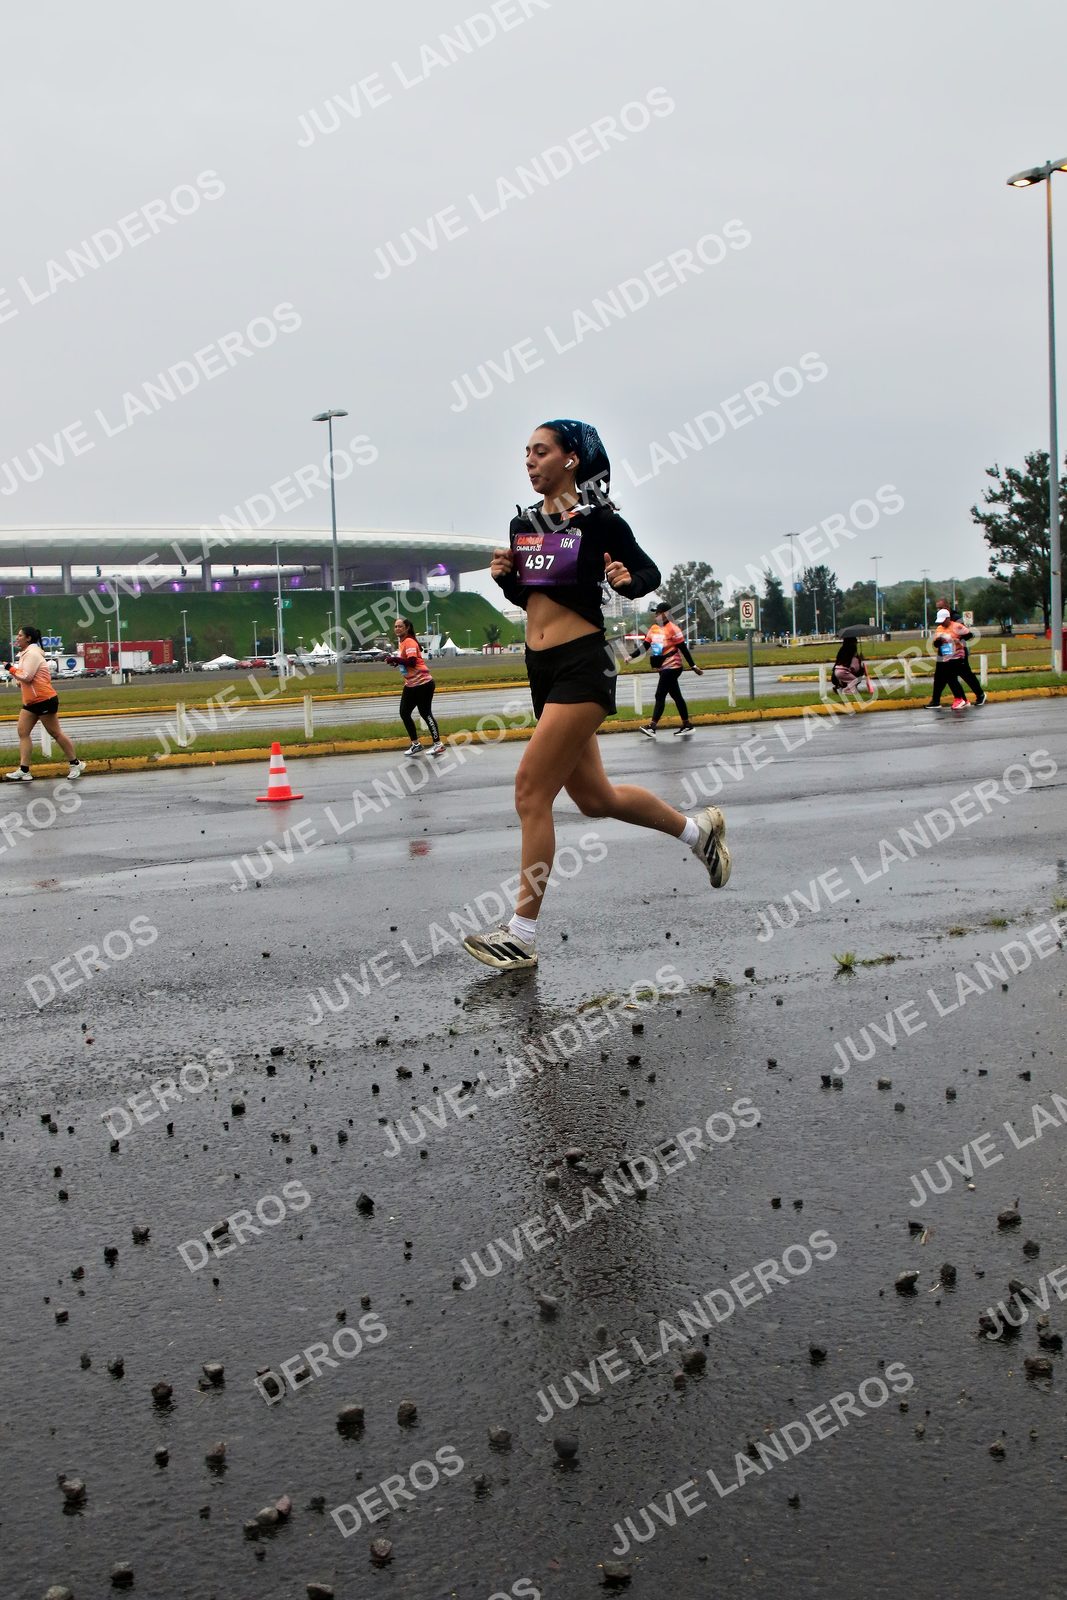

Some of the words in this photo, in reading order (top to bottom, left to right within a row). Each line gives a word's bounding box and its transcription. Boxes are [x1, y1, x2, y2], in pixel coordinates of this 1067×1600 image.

[560, 538, 575, 548] 16K
[525, 554, 554, 570] 497
[41, 636, 60, 646] ON
